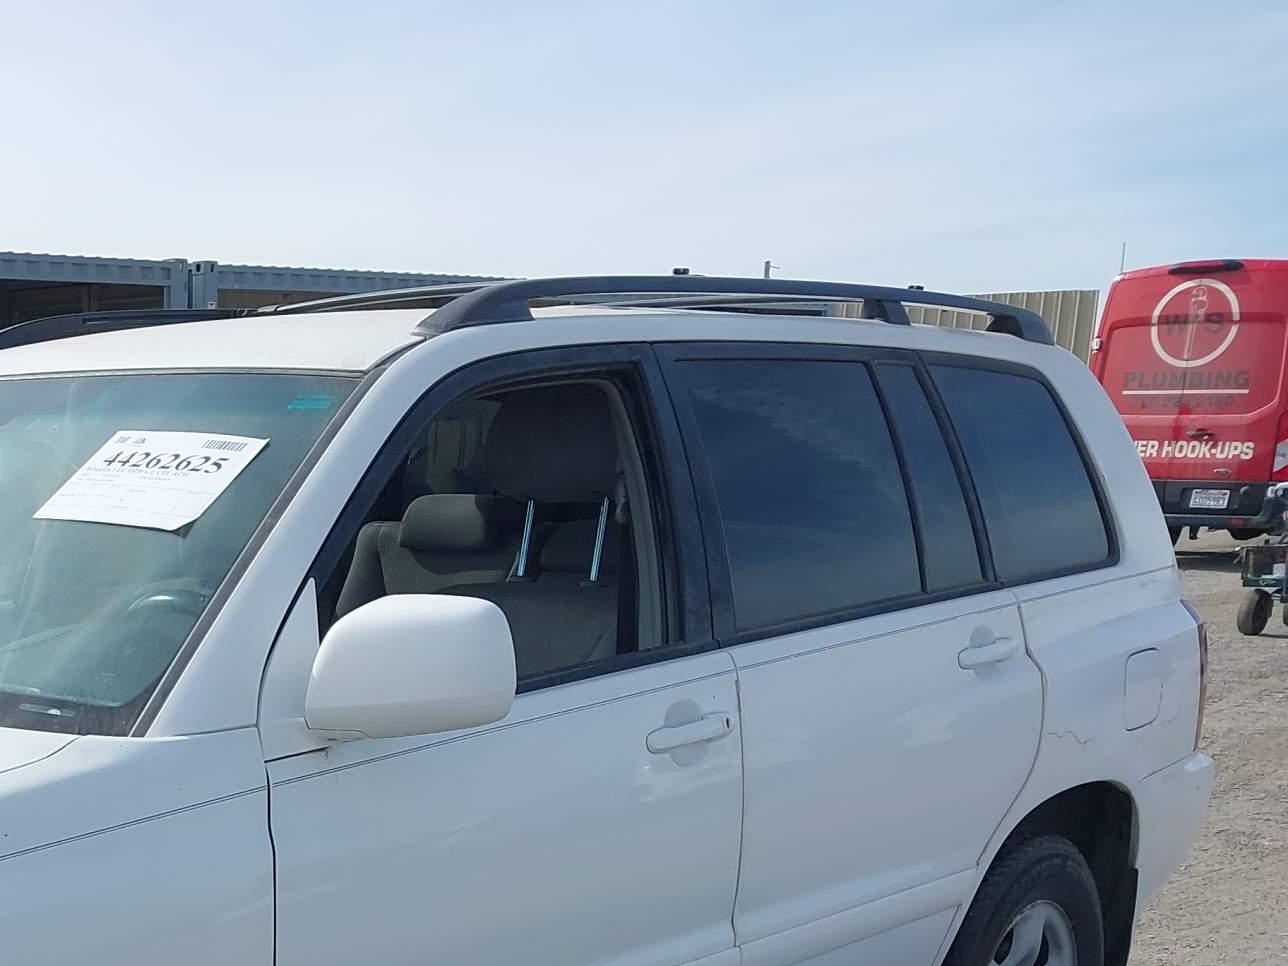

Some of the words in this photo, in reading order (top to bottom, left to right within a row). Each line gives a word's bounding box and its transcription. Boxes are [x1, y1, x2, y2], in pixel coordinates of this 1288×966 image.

[1122, 370, 1250, 388] PLUMBING
[1134, 440, 1159, 457] ER
[1161, 440, 1255, 459] HOOK-UPS
[103, 451, 230, 474] 44262625
